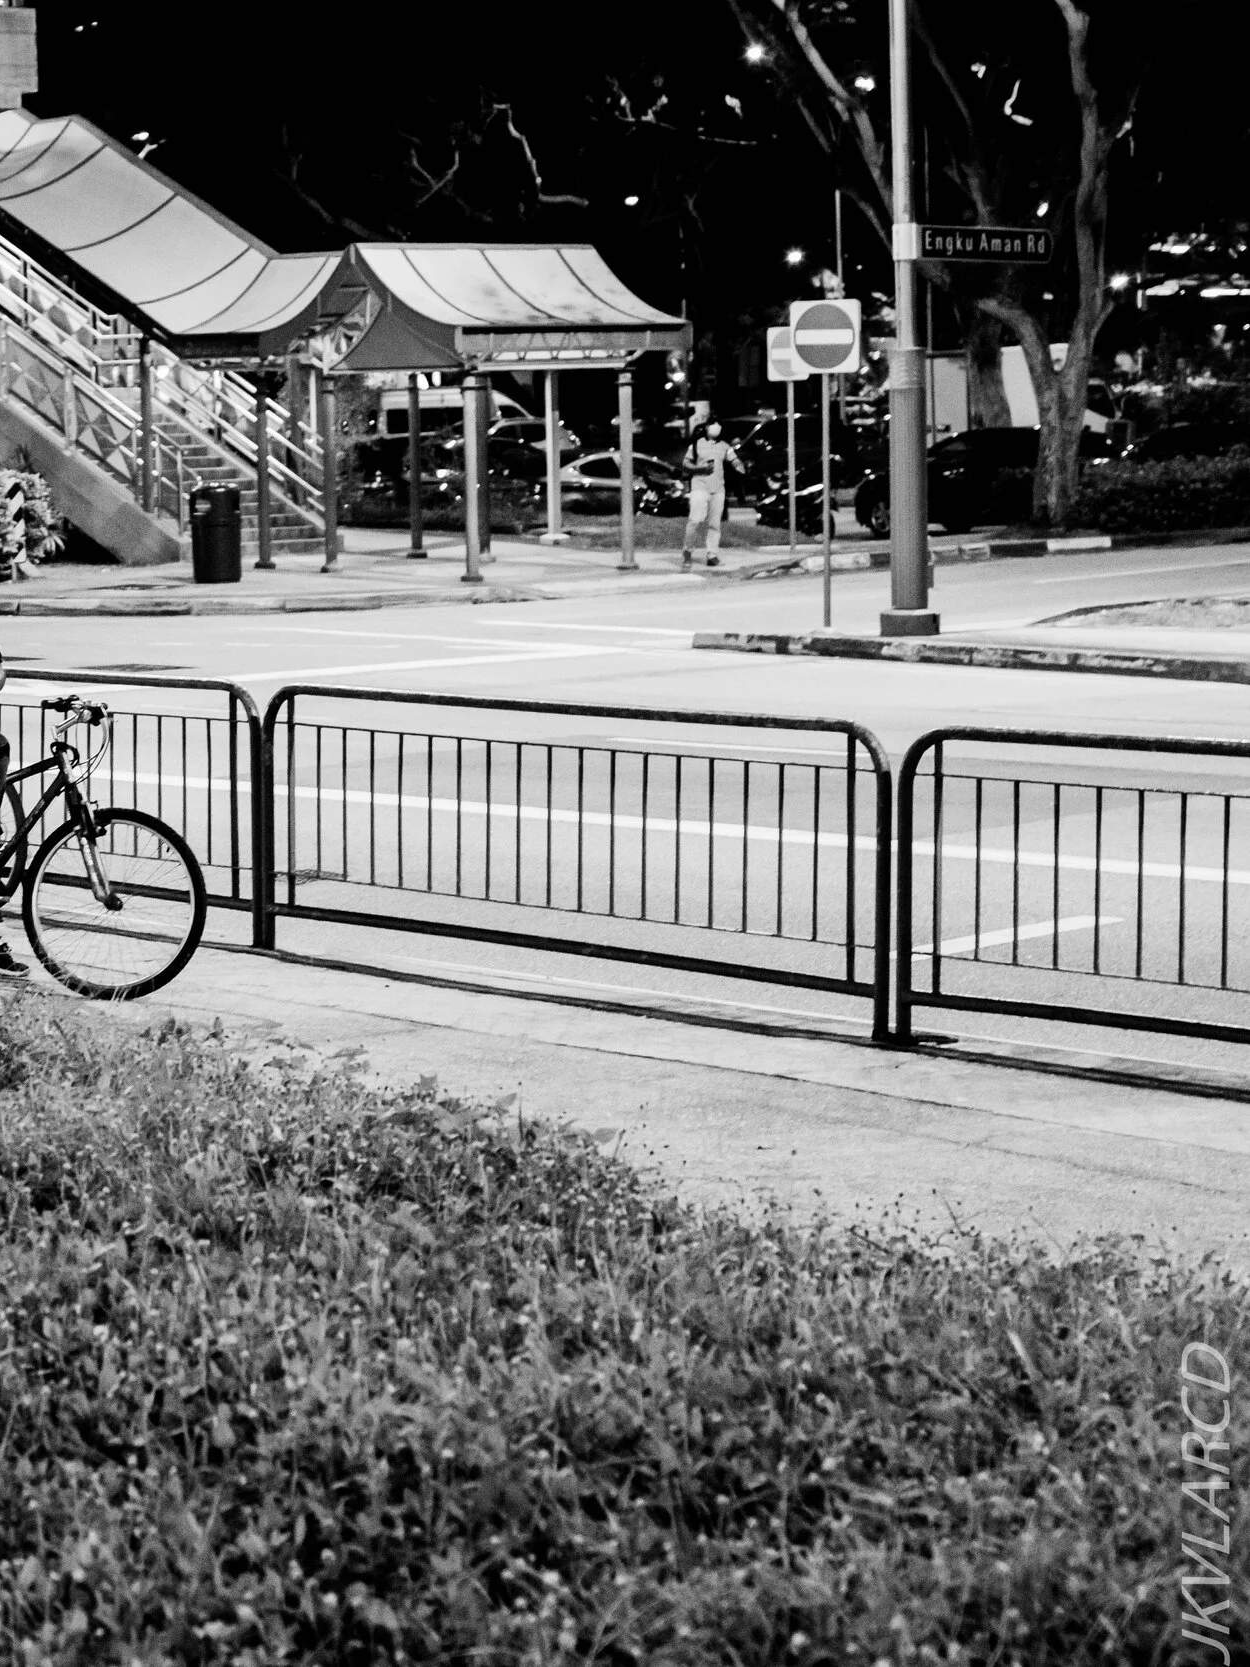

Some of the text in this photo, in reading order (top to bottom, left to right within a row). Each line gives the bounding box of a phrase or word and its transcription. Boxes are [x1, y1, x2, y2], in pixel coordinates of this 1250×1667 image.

[925, 230, 1046, 256] Engku Aman Rd
